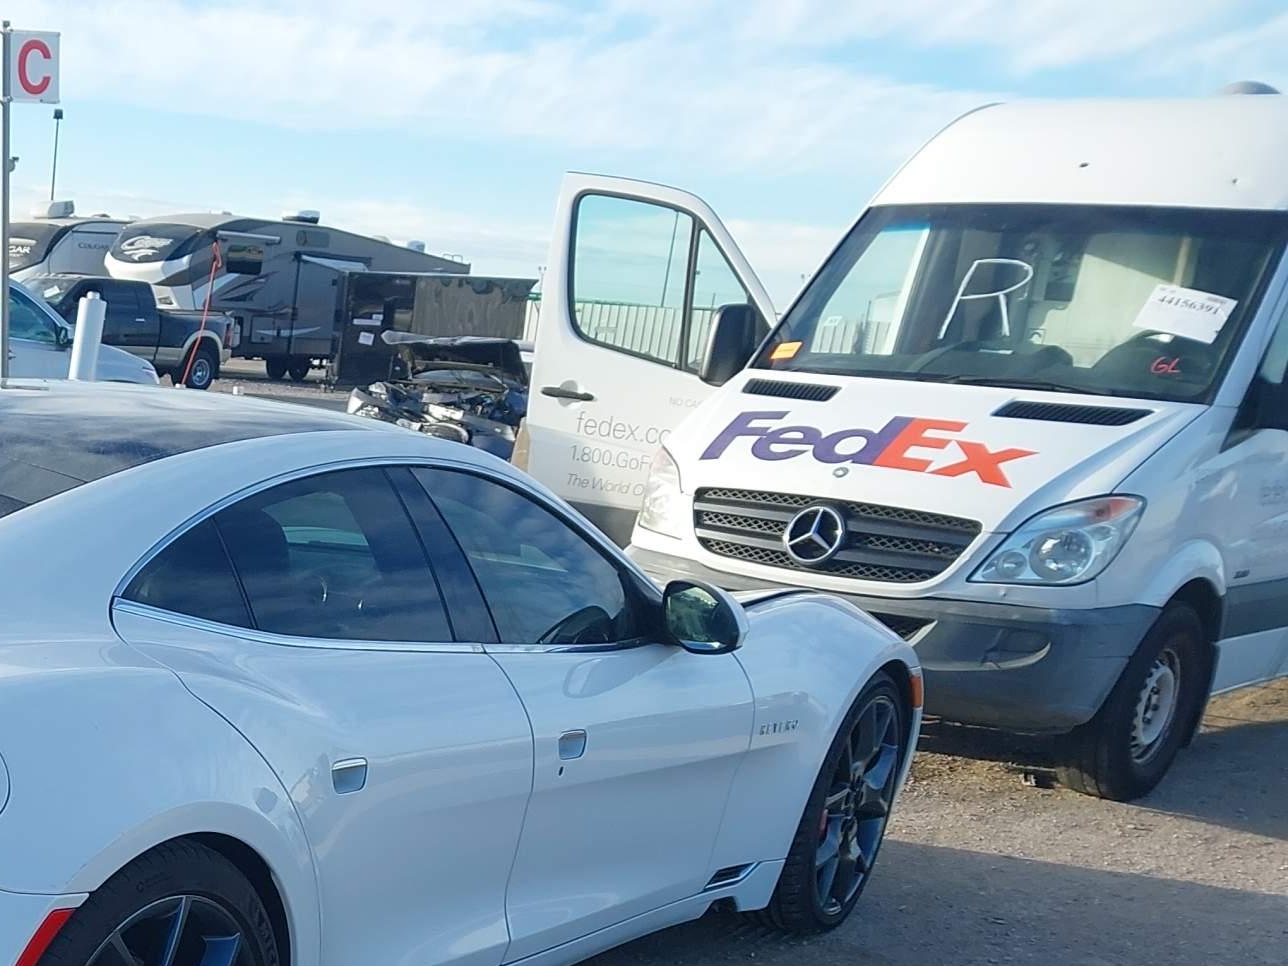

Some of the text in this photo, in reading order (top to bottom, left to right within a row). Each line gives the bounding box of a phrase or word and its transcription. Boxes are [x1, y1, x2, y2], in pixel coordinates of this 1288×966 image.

[18, 39, 51, 95] C
[938, 258, 1034, 340] R
[698, 410, 1040, 489] FedEx
[568, 473, 589, 489] The
[592, 477, 630, 494] World
